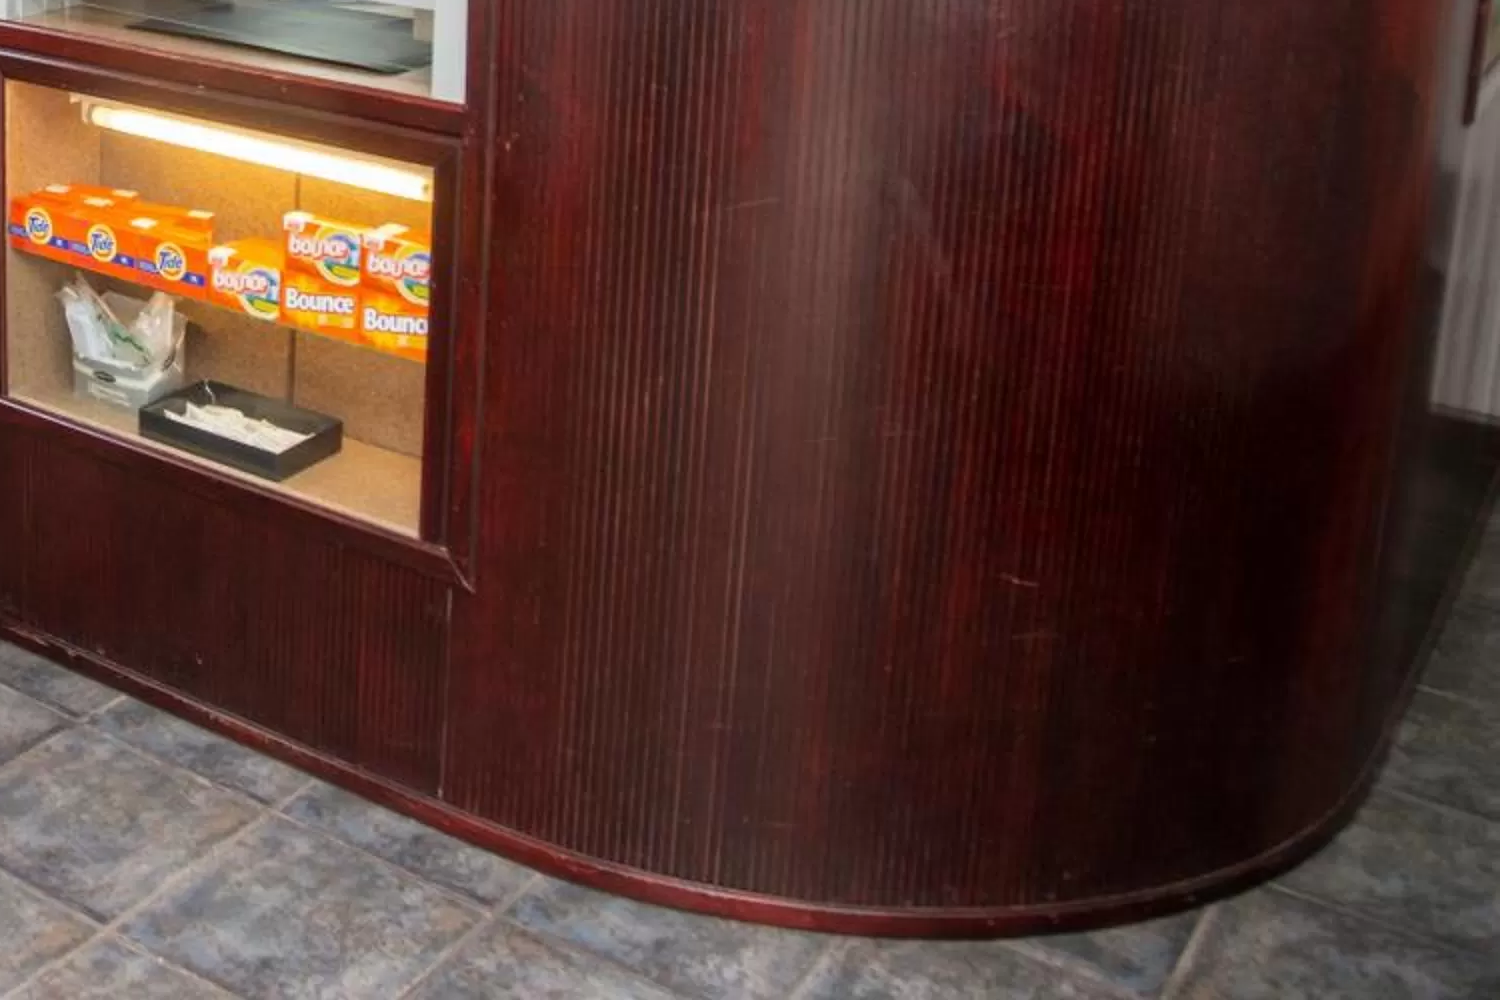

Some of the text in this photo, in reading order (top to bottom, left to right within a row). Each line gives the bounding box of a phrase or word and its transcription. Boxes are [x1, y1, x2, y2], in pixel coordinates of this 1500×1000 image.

[28, 217, 50, 234] Tide
[91, 233, 114, 250] Tide
[289, 232, 348, 260] bounce
[159, 251, 182, 269] Tide
[213, 270, 268, 293] bounce
[286, 288, 354, 313] Bounce
[364, 308, 428, 335] Bounc
